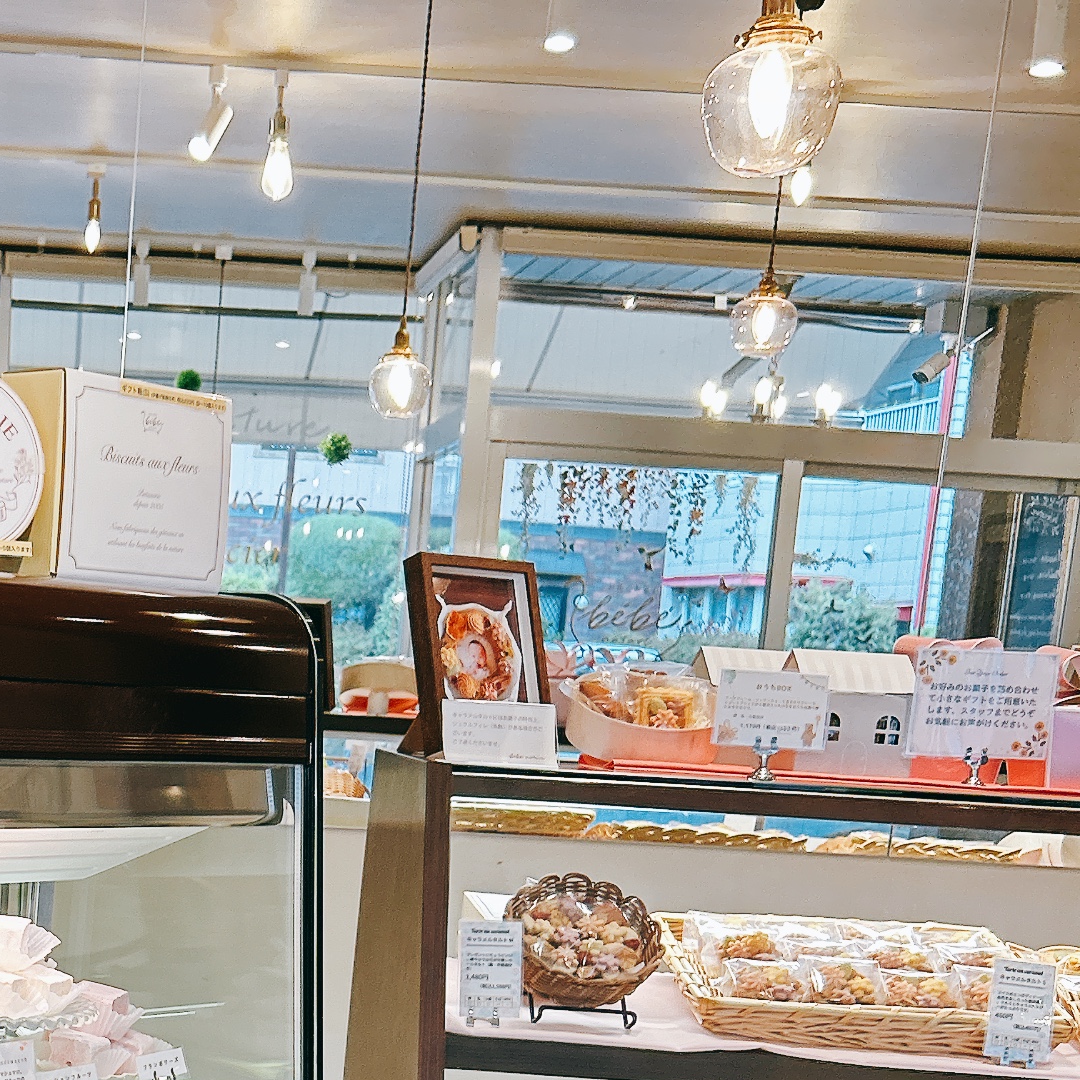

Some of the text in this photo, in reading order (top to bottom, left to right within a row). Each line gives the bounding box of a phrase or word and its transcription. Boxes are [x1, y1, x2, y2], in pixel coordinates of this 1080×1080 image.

[100, 443, 201, 476] Biscuits aux fleurs
[930, 683, 1039, 695] お好みのお菓子を詰め合わせ
[929, 694, 1037, 706] て小さなギフトをご用意いた
[928, 706, 1036, 718] します。スタッフまでどうぞ
[925, 718, 1029, 729] お気軽にお声がけください。
